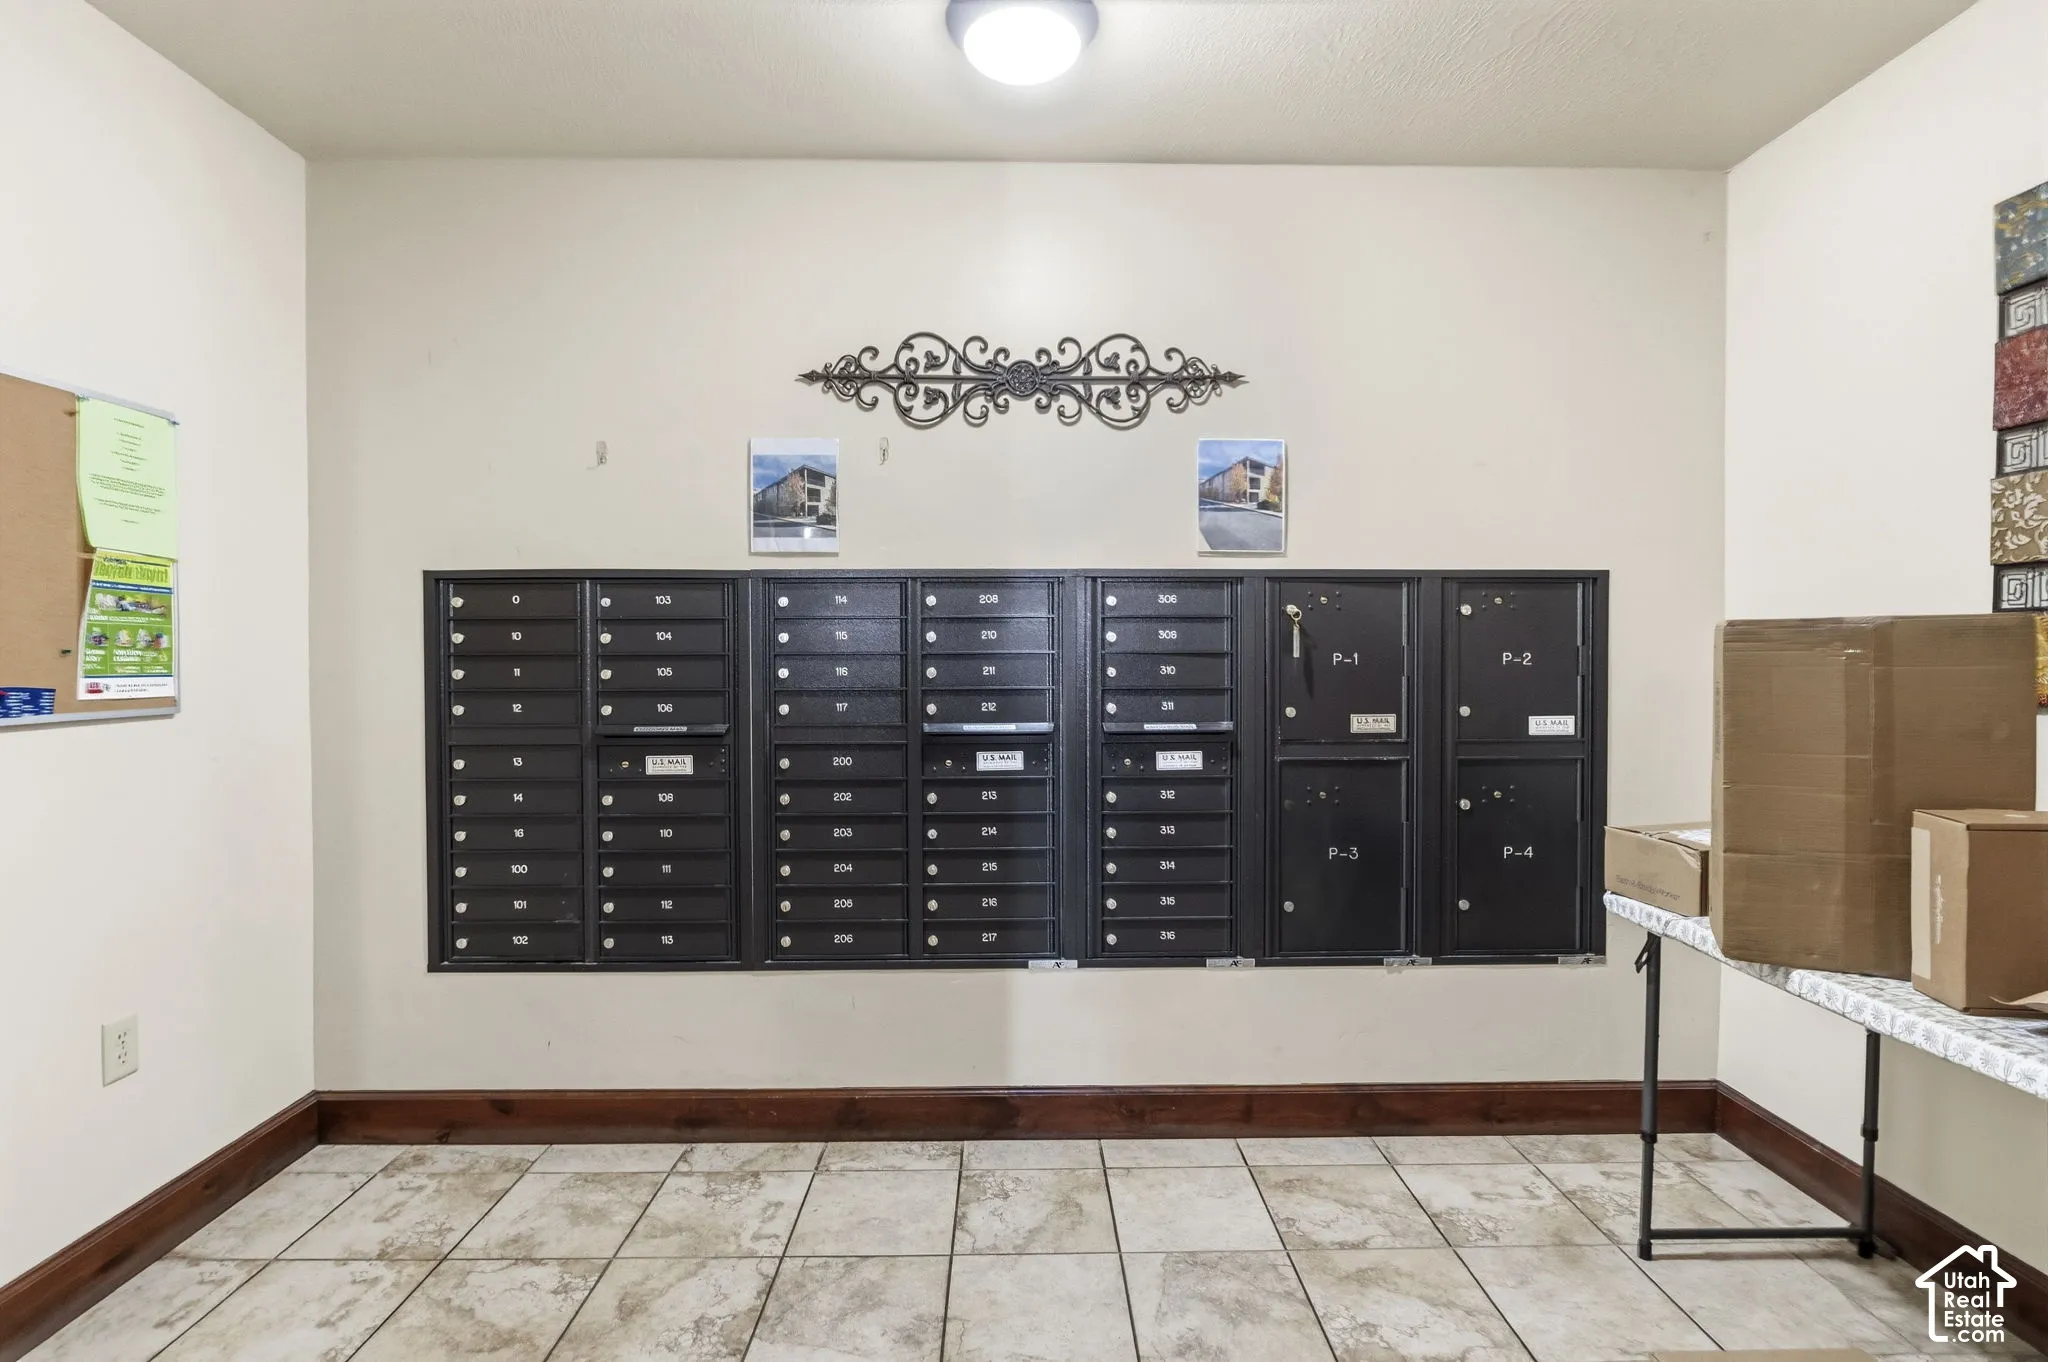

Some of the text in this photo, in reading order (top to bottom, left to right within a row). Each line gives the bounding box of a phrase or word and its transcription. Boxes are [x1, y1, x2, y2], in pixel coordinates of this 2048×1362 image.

[655, 595, 672, 605] 103
[835, 595, 848, 605] 114
[511, 631, 522, 641] 10
[655, 631, 673, 641] 104
[835, 630, 848, 640] 115
[981, 630, 998, 640] 210
[1332, 652, 1358, 666] P-1
[1502, 652, 1532, 666] P-2
[513, 668, 521, 677] 11
[656, 667, 673, 677] 105
[835, 666, 849, 677] 116
[982, 665, 996, 676] 211
[1159, 665, 1176, 675] 310
[512, 703, 522, 713] 12
[657, 703, 673, 713] 106
[836, 702, 849, 712] 117
[981, 702, 997, 712] 212
[1161, 701, 1174, 711] 311
[832, 756, 853, 766] 200
[513, 793, 524, 802] 14
[658, 792, 674, 803] 108
[833, 792, 852, 802] 202
[981, 790, 998, 800] 213
[1160, 790, 1176, 800] 312
[513, 828, 525, 838] 16
[659, 828, 673, 838] 110
[833, 827, 853, 838] 203
[981, 826, 998, 836] 214
[1159, 825, 1176, 835] 313
[1329, 847, 1359, 860] P-3
[1503, 846, 1534, 859] P-4
[511, 864, 528, 874] 100
[661, 864, 672, 874] 111
[833, 863, 853, 873] 204
[982, 862, 998, 872] 215
[1159, 860, 1176, 870] 314
[513, 900, 527, 910] 101
[660, 900, 673, 909] 112
[982, 897, 998, 907] 216
[1159, 896, 1176, 906] 315
[512, 935, 529, 945] 102
[661, 935, 674, 945] 113
[834, 934, 854, 944] 206
[982, 932, 998, 942] 217
[1159, 930, 1176, 940] 316
